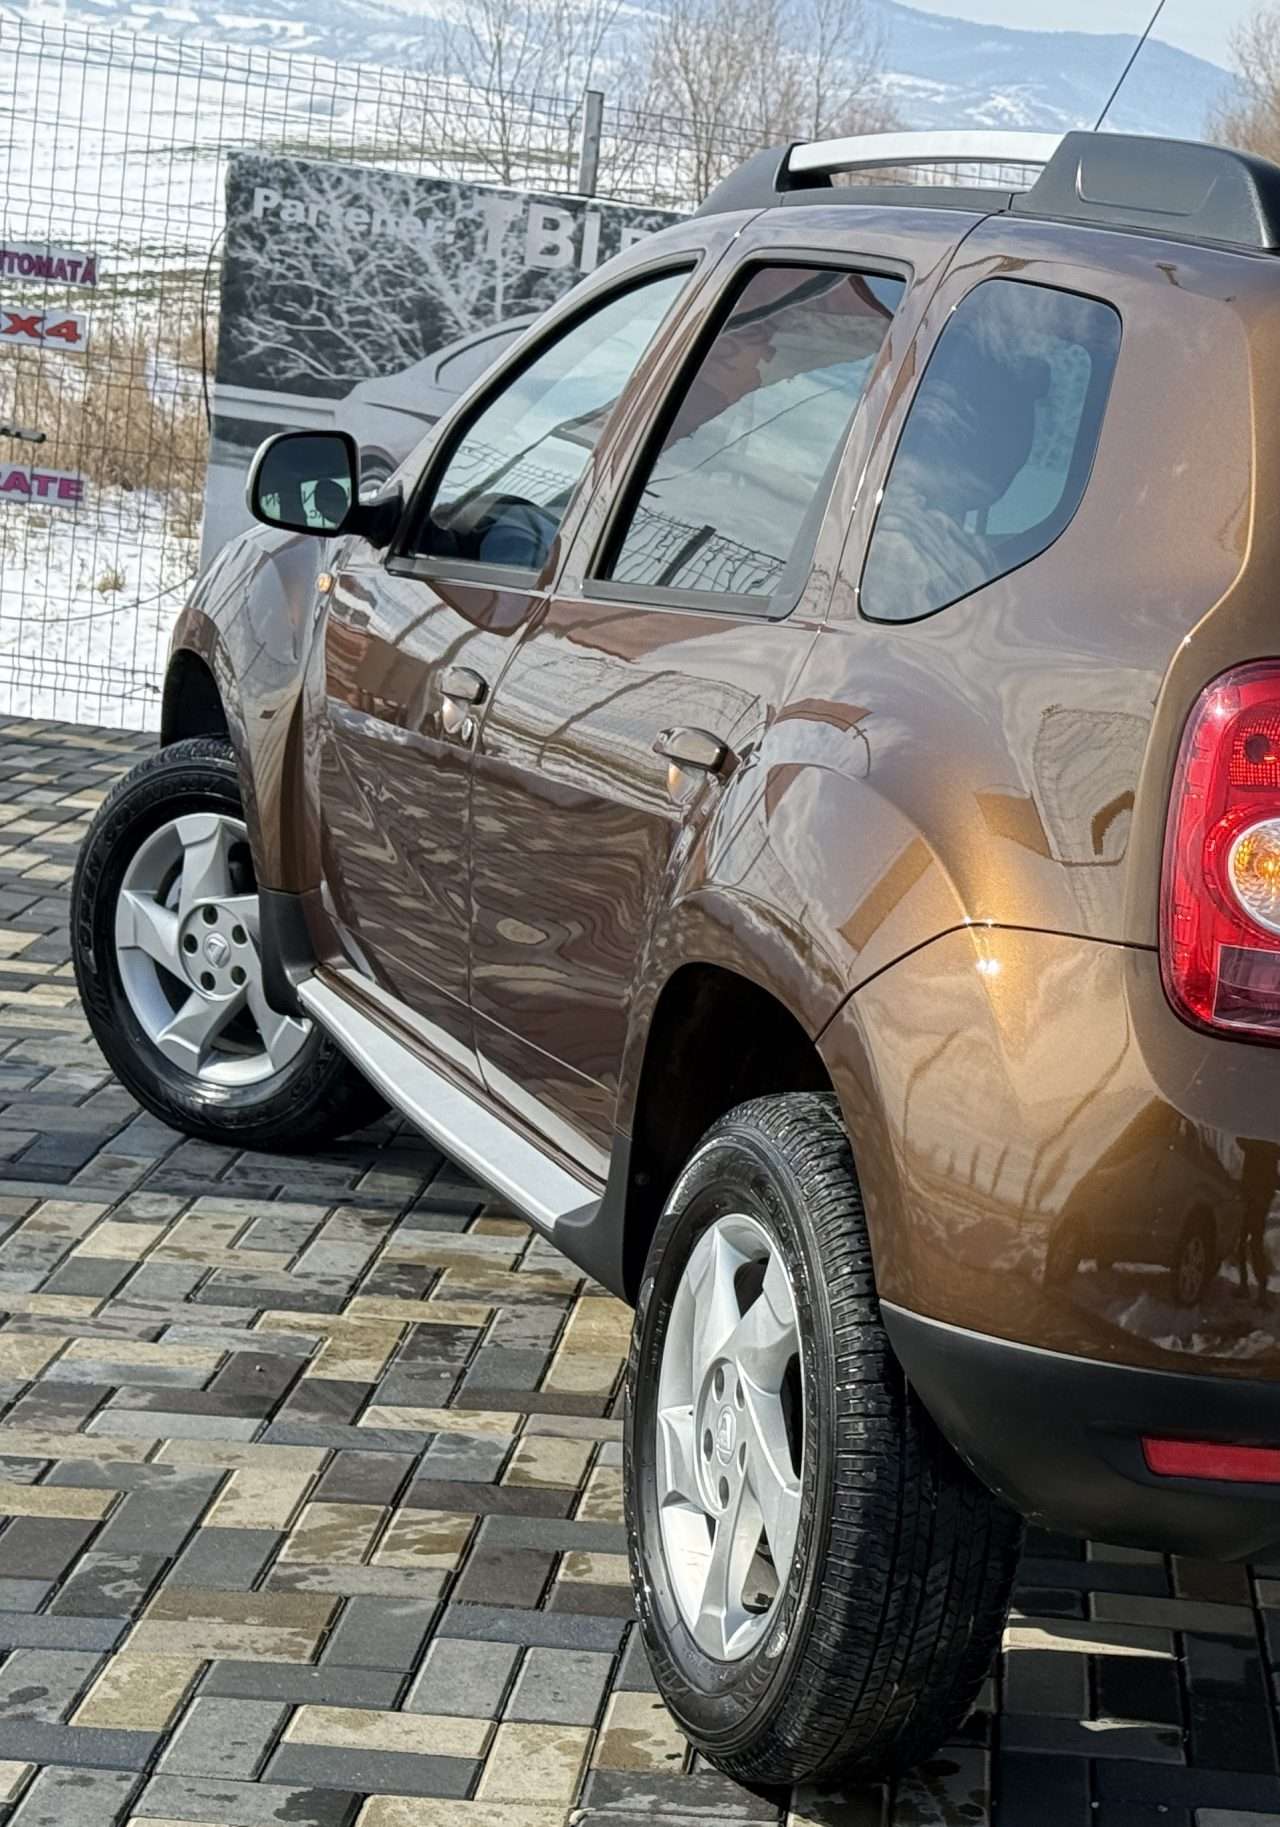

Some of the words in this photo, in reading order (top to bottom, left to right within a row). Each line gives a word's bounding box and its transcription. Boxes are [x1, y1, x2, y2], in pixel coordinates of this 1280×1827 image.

[253, 187, 456, 244] Partener:
[484, 197, 600, 274] TBI
[0, 311, 82, 344] X4
[0, 470, 84, 501] ATE
